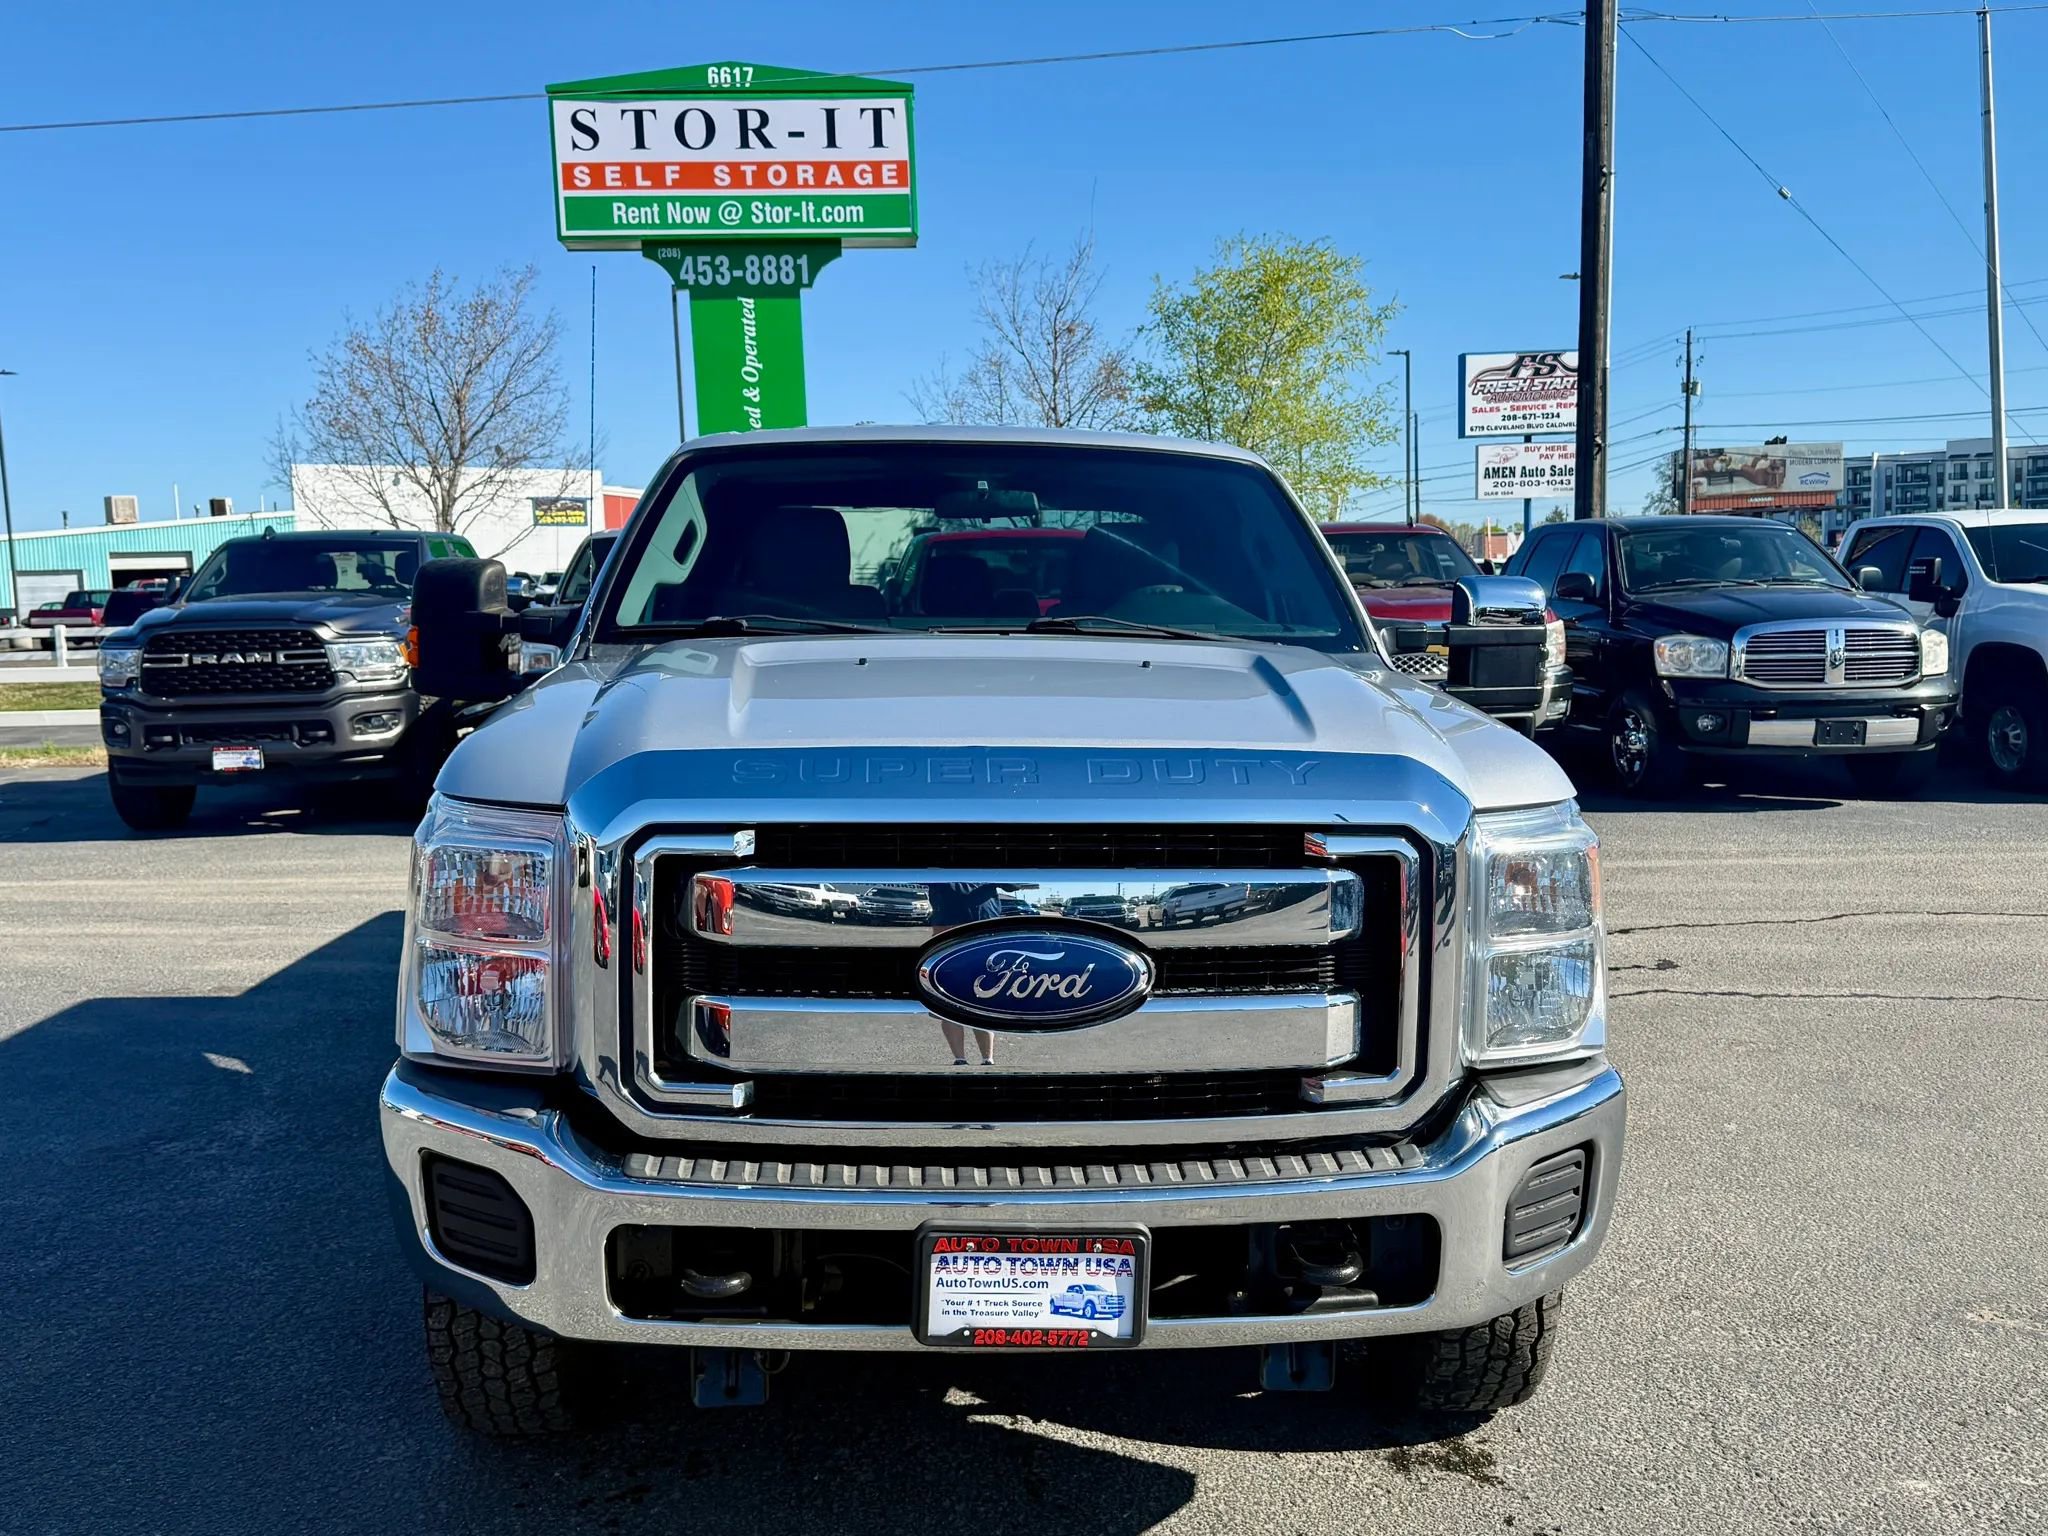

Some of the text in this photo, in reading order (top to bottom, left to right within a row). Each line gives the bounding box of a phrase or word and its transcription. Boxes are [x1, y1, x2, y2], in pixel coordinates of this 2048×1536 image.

[707, 67, 754, 87] 6617
[570, 107, 896, 152] STOR-IT
[573, 163, 898, 188] SELF STORAGE
[612, 201, 864, 226] Rent Now @ Stor-It.com
[657, 247, 810, 286] (208) 453-8881
[737, 296, 763, 431] ed & Operated
[1472, 378, 1531, 395] FRESH
[1487, 389, 1570, 405] AUTOMOTIVE
[1509, 403, 1547, 412] SERVICE
[1501, 412, 1561, 422] 208-671-1234
[1545, 421, 1577, 429] CALDWEL
[1524, 444, 1568, 453] BUY HERE
[1558, 452, 1575, 460] HER
[1483, 464, 1574, 480] AMEN Auto Sale
[1492, 479, 1571, 488] 208-803-1043
[192, 652, 272, 665] RAM
[731, 757, 1321, 786] SUPER DUTY
[973, 949, 1096, 999] Ford
[932, 1237, 1136, 1255] AUTO TOWN USA
[934, 1255, 1134, 1278] AUTO TOWN USA
[935, 1277, 1049, 1289] AutoTownUS.com
[984, 1299, 1009, 1307] Truck
[1011, 1299, 1043, 1307] Source
[941, 1308, 950, 1316] in
[952, 1308, 968, 1316] the
[969, 1309, 1010, 1317] Treasure
[973, 1328, 1089, 1346] 208-402-5772
